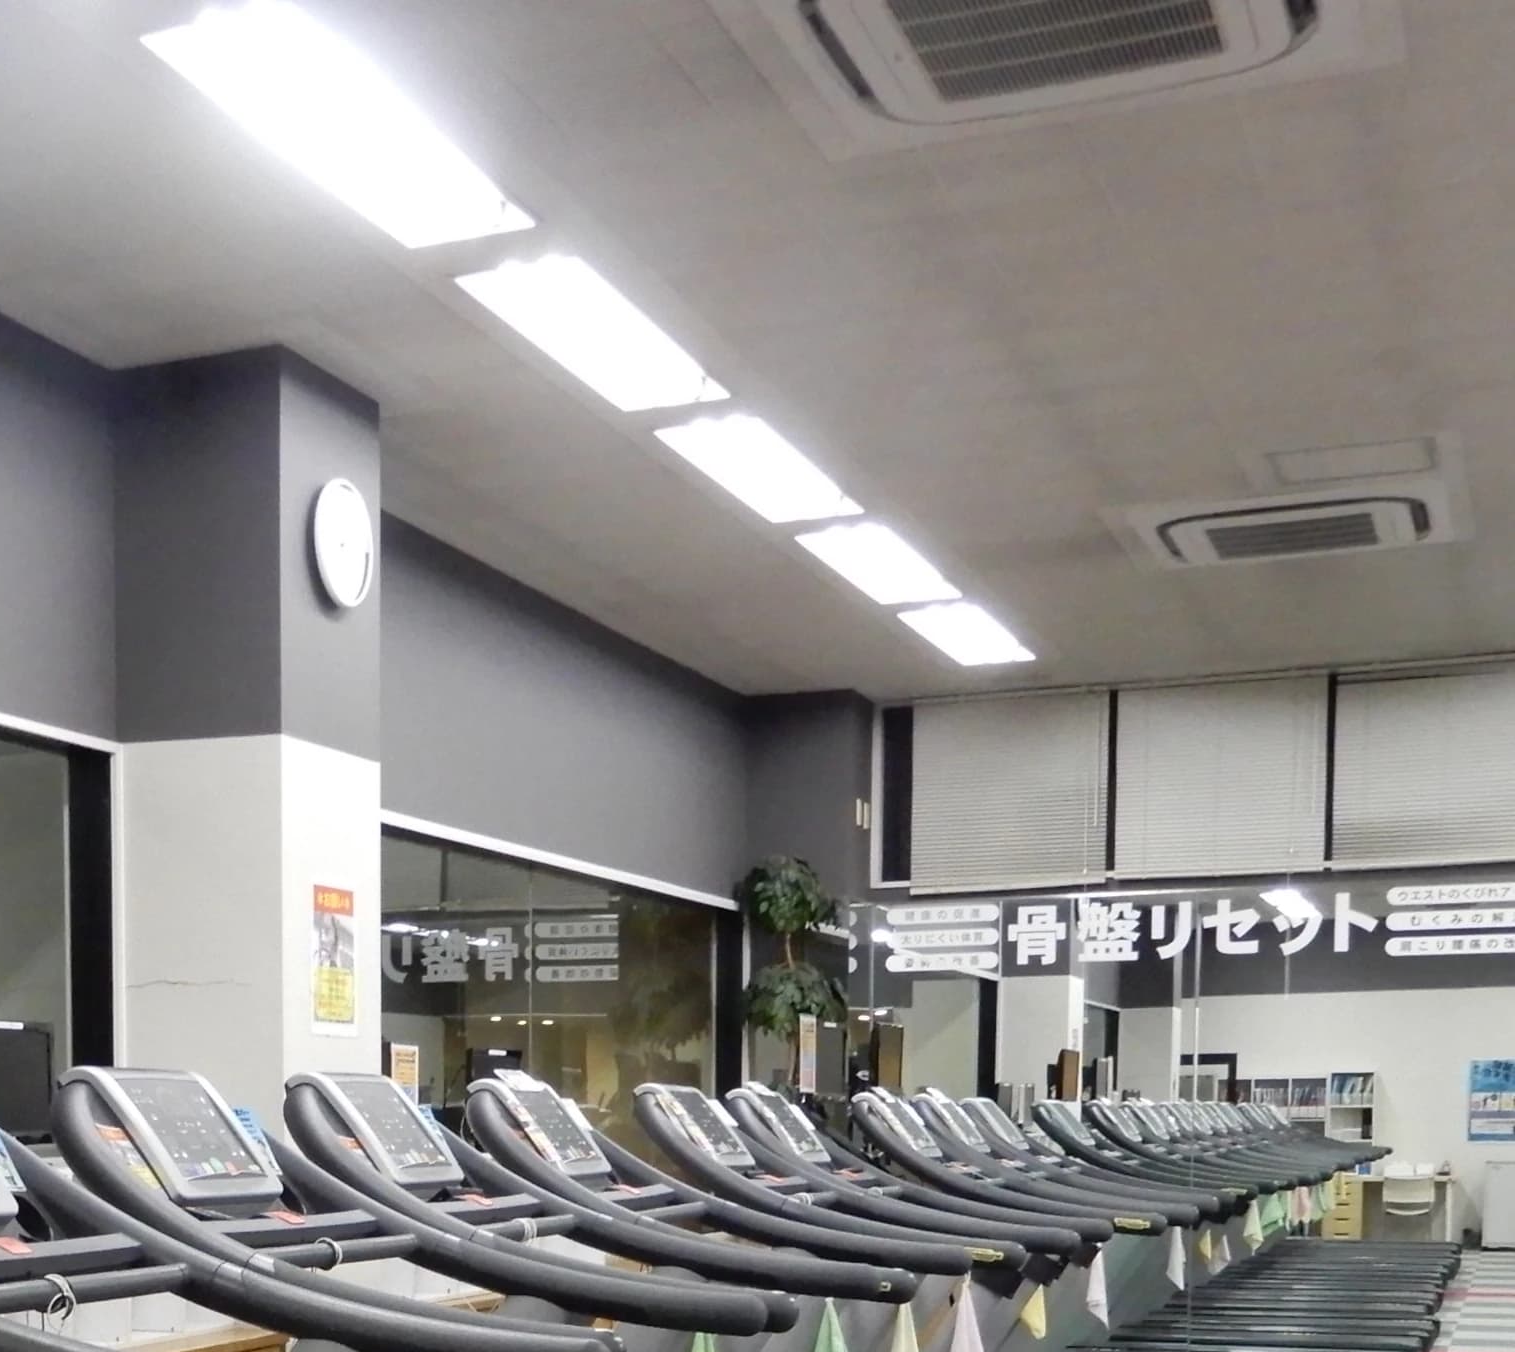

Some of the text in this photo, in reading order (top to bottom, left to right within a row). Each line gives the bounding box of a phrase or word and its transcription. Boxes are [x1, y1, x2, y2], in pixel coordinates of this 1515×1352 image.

[1007, 891, 1379, 966] 骨盤リセット
[1411, 912, 1515, 926] むくみの解
